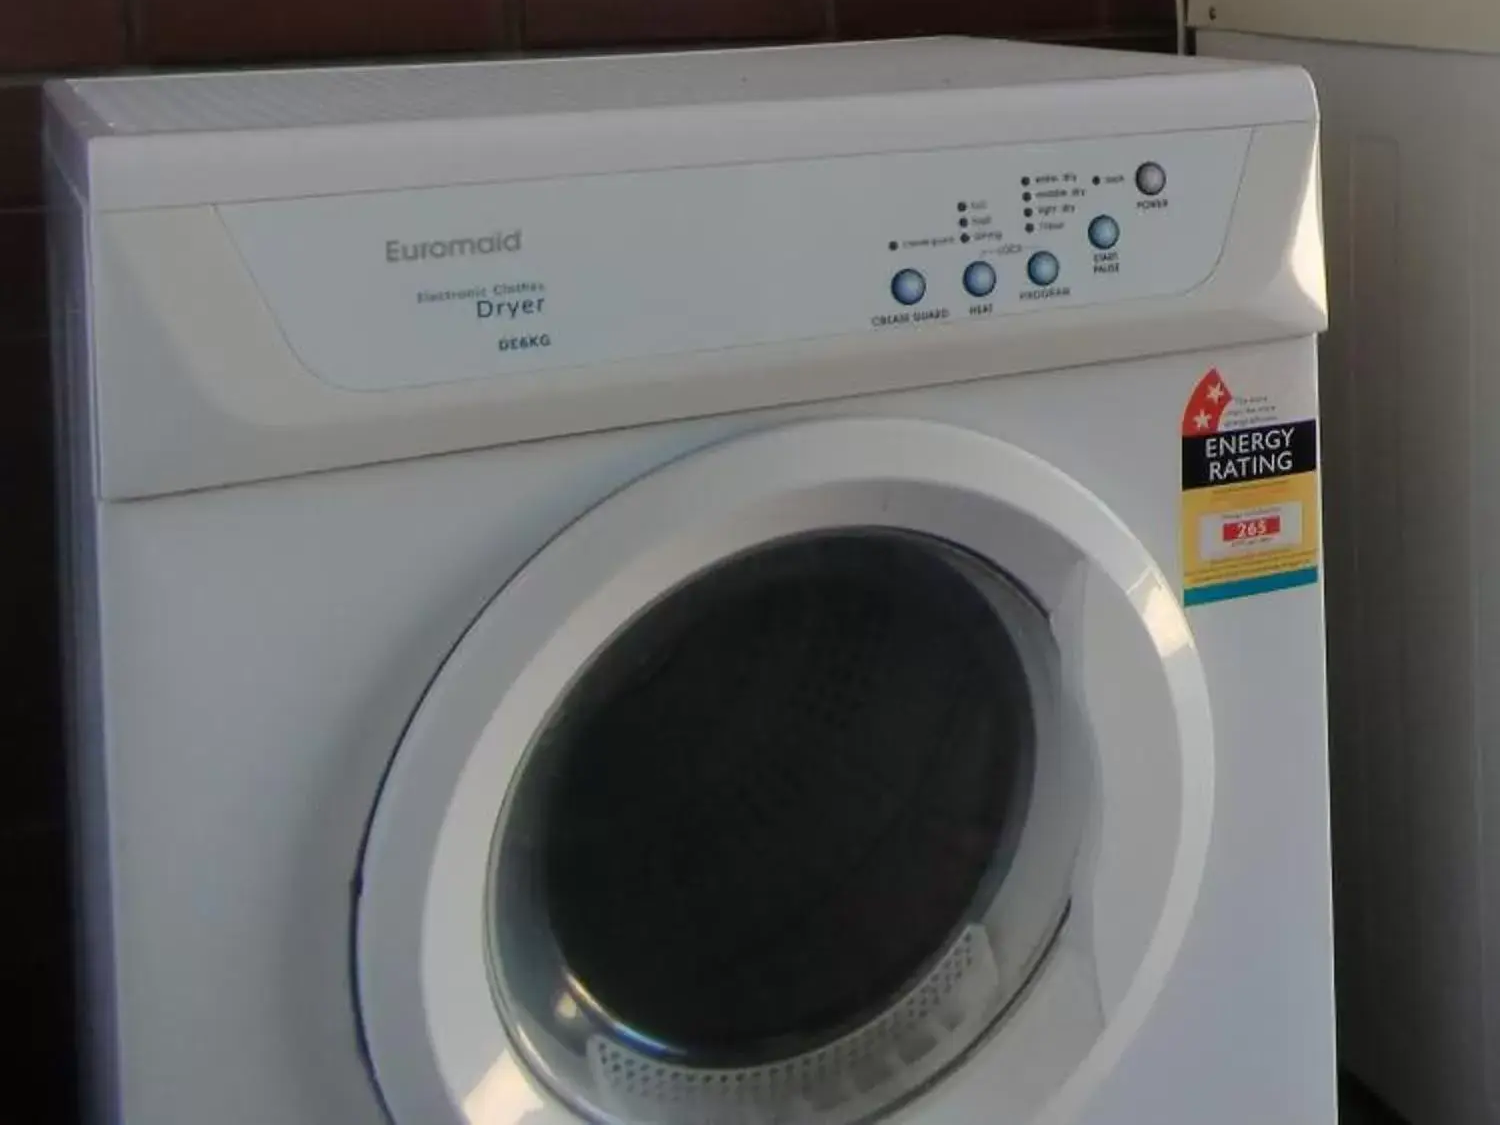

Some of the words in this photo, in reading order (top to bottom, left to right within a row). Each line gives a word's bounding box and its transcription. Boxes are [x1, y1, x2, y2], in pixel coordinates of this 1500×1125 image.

[1136, 199, 1169, 210] POWER
[385, 229, 522, 263] Euromaid
[476, 298, 546, 319] Dryer
[1204, 426, 1296, 459] ENERGY
[1208, 450, 1293, 482] RATING
